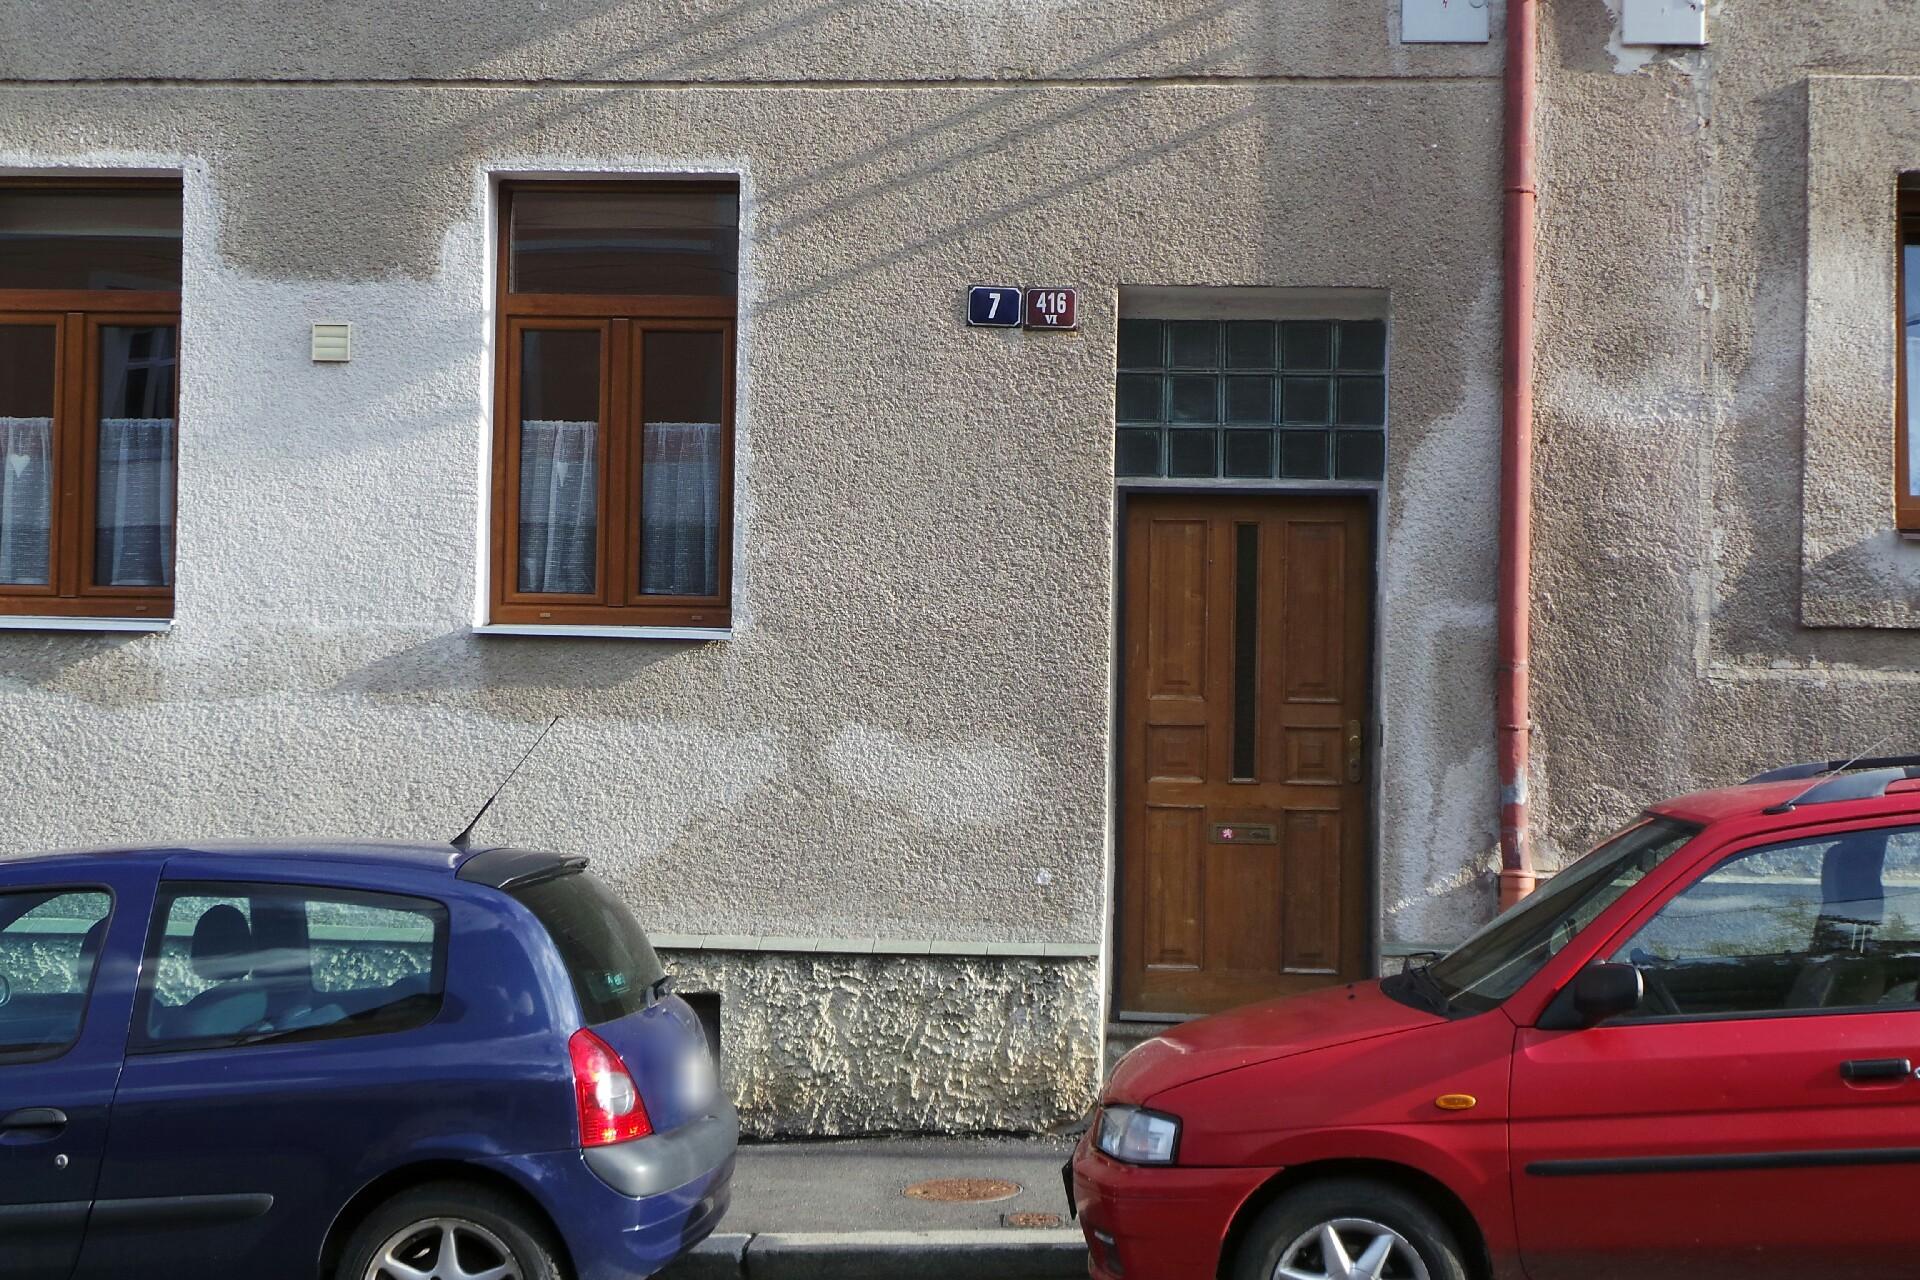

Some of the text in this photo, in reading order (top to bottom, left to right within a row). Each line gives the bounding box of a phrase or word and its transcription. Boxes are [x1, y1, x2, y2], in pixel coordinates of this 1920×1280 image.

[988, 292, 1001, 319] 7
[1036, 292, 1066, 314] 416
[1044, 314, 1058, 325] VI
